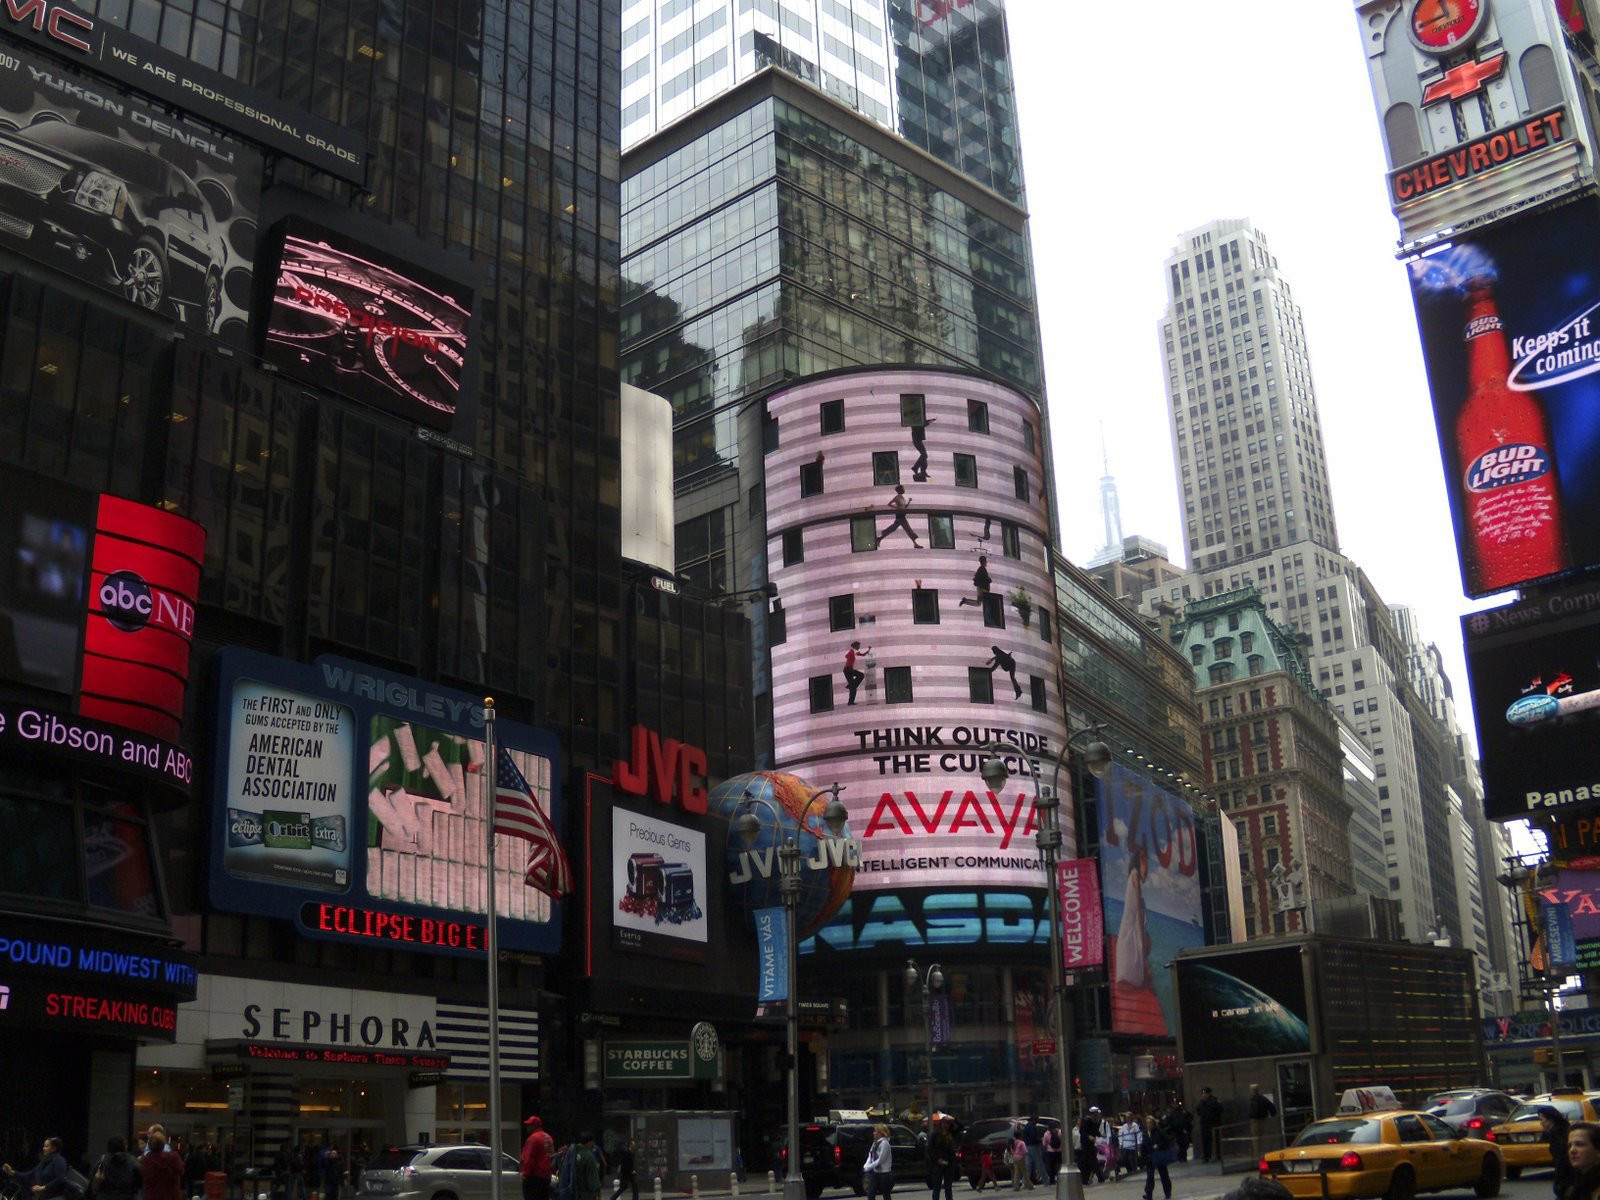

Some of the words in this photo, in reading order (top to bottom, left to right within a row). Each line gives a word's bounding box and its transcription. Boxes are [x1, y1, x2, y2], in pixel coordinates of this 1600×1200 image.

[112, 46, 137, 66] WE
[143, 63, 176, 83] ARE
[181, 78, 301, 139] PROFESSIONAL
[28, 65, 124, 117] YUKON
[131, 110, 234, 164] DENALI
[1394, 112, 1563, 200] CHEVROLET
[1466, 323, 1502, 339] LIGHT
[1470, 316, 1499, 329] BUD
[1512, 331, 1569, 359] Keeps
[1574, 317, 1591, 340] it
[1480, 445, 1537, 471] BUD
[1472, 459, 1545, 489] LIGHT
[100, 581, 152, 614] abc
[656, 578, 677, 593] FUEL
[1493, 606, 1542, 627] News
[243, 698, 257, 711] THE
[260, 696, 294, 715] FIRST
[296, 704, 311, 717] AND
[315, 703, 342, 720] ONLY
[322, 663, 486, 729] WRIGLEY'S
[245, 713, 268, 727] GUMS
[270, 717, 311, 732] ACCEPTED
[313, 721, 323, 733] BY
[326, 723, 339, 735] THE
[18, 710, 113, 756] Gibson
[122, 740, 160, 769] and
[164, 749, 192, 785] ABC
[249, 733, 323, 759] AMERICAN
[854, 726, 943, 750] THINK
[953, 726, 1048, 752] OUTSIDE
[246, 755, 300, 778] DENTAL
[613, 723, 709, 816] JVC
[874, 753, 931, 776] THE
[939, 753, 1041, 778] CUCLE
[242, 777, 337, 802] ASSOCIATION
[231, 819, 262, 838] eclipse
[268, 821, 310, 837] Orbit
[315, 826, 337, 840] Extra
[629, 822, 665, 847] Precious
[667, 833, 691, 853] Gems
[808, 838, 863, 871] JVC
[855, 856, 949, 873] TELLIGENT
[954, 855, 1050, 872] COMMUNICAT
[319, 903, 416, 941] ECLIPSE
[421, 919, 461, 947] BIG
[1062, 867, 1083, 964] WELCOME
[79, 947, 161, 981] MIDWEST
[46, 992, 149, 1025] STREAKING
[151, 1004, 176, 1031] CUBS
[243, 1004, 437, 1049] SEPHORA
[249, 1045, 299, 1060] Welcome
[323, 1050, 369, 1064] Sephora
[608, 1049, 688, 1060] STARBUCKS
[623, 1060, 673, 1071] COFFEE
